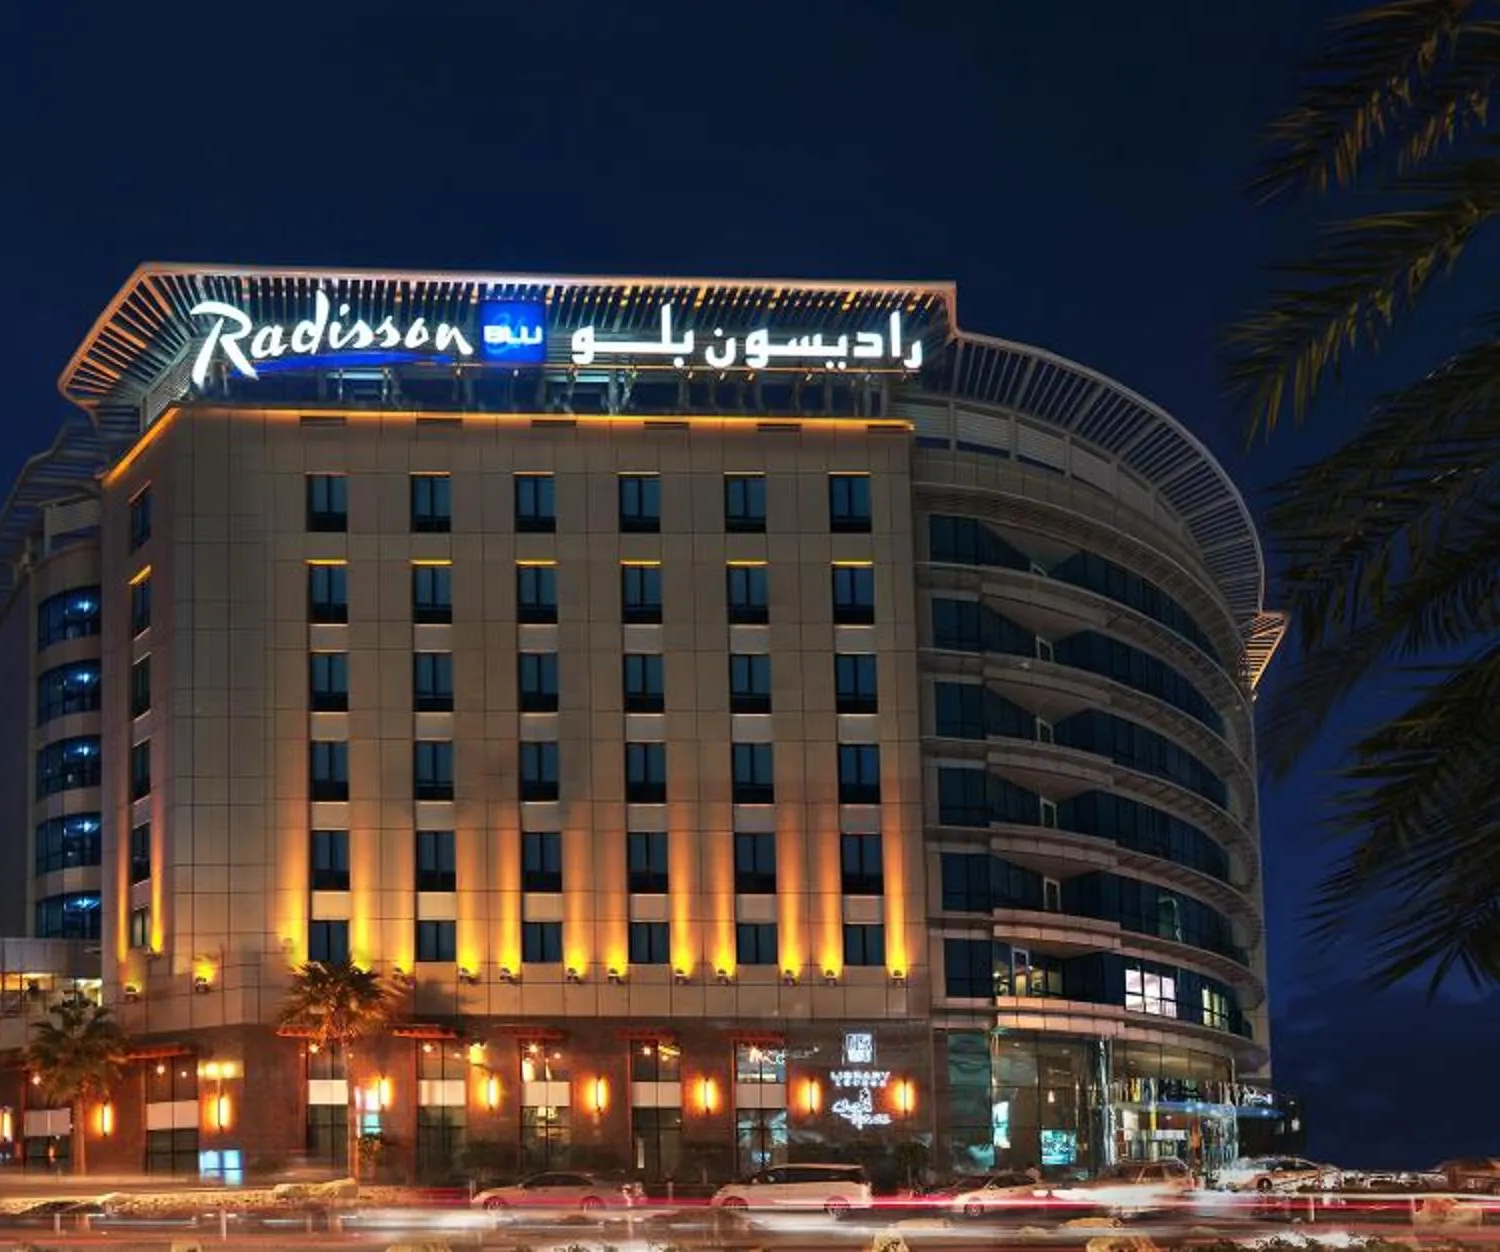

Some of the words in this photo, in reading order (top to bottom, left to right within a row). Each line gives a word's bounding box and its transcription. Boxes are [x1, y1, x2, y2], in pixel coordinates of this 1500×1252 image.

[190, 289, 474, 387] Radisson
[572, 305, 694, 370] بلو
[706, 312, 923, 369] راديسون
